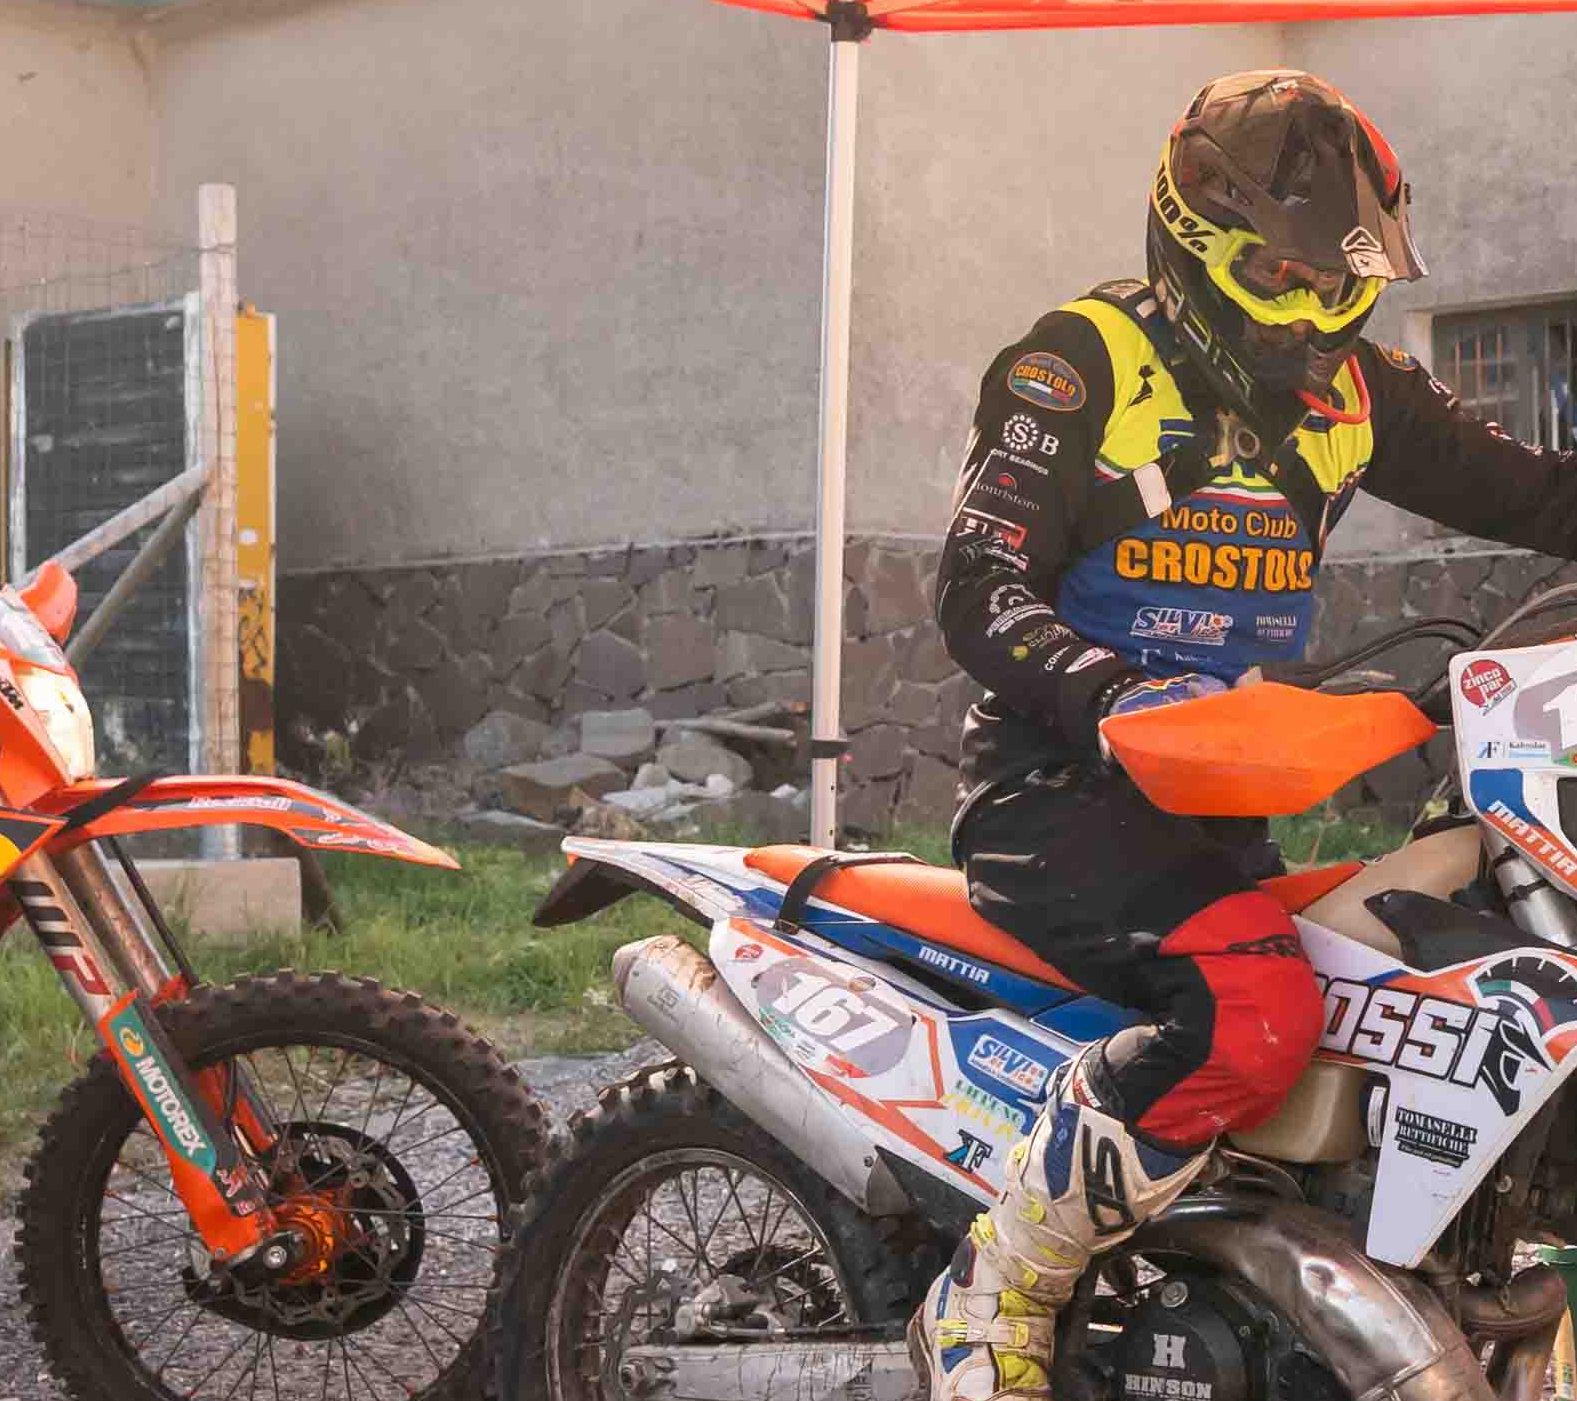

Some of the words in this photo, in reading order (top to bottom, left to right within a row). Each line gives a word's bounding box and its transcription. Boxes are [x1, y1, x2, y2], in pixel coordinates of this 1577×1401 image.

[1161, 506, 1238, 534] Moto
[1245, 511, 1298, 539] Club
[773, 970, 899, 1053] 167
[1313, 973, 1501, 1090] OSSI
[135, 1054, 209, 1157] MOTOREX
[1395, 1107, 1478, 1143] TOMASELLI
[1397, 1124, 1471, 1155] RETTIFICHE
[1125, 1372, 1213, 1401] HINSON
